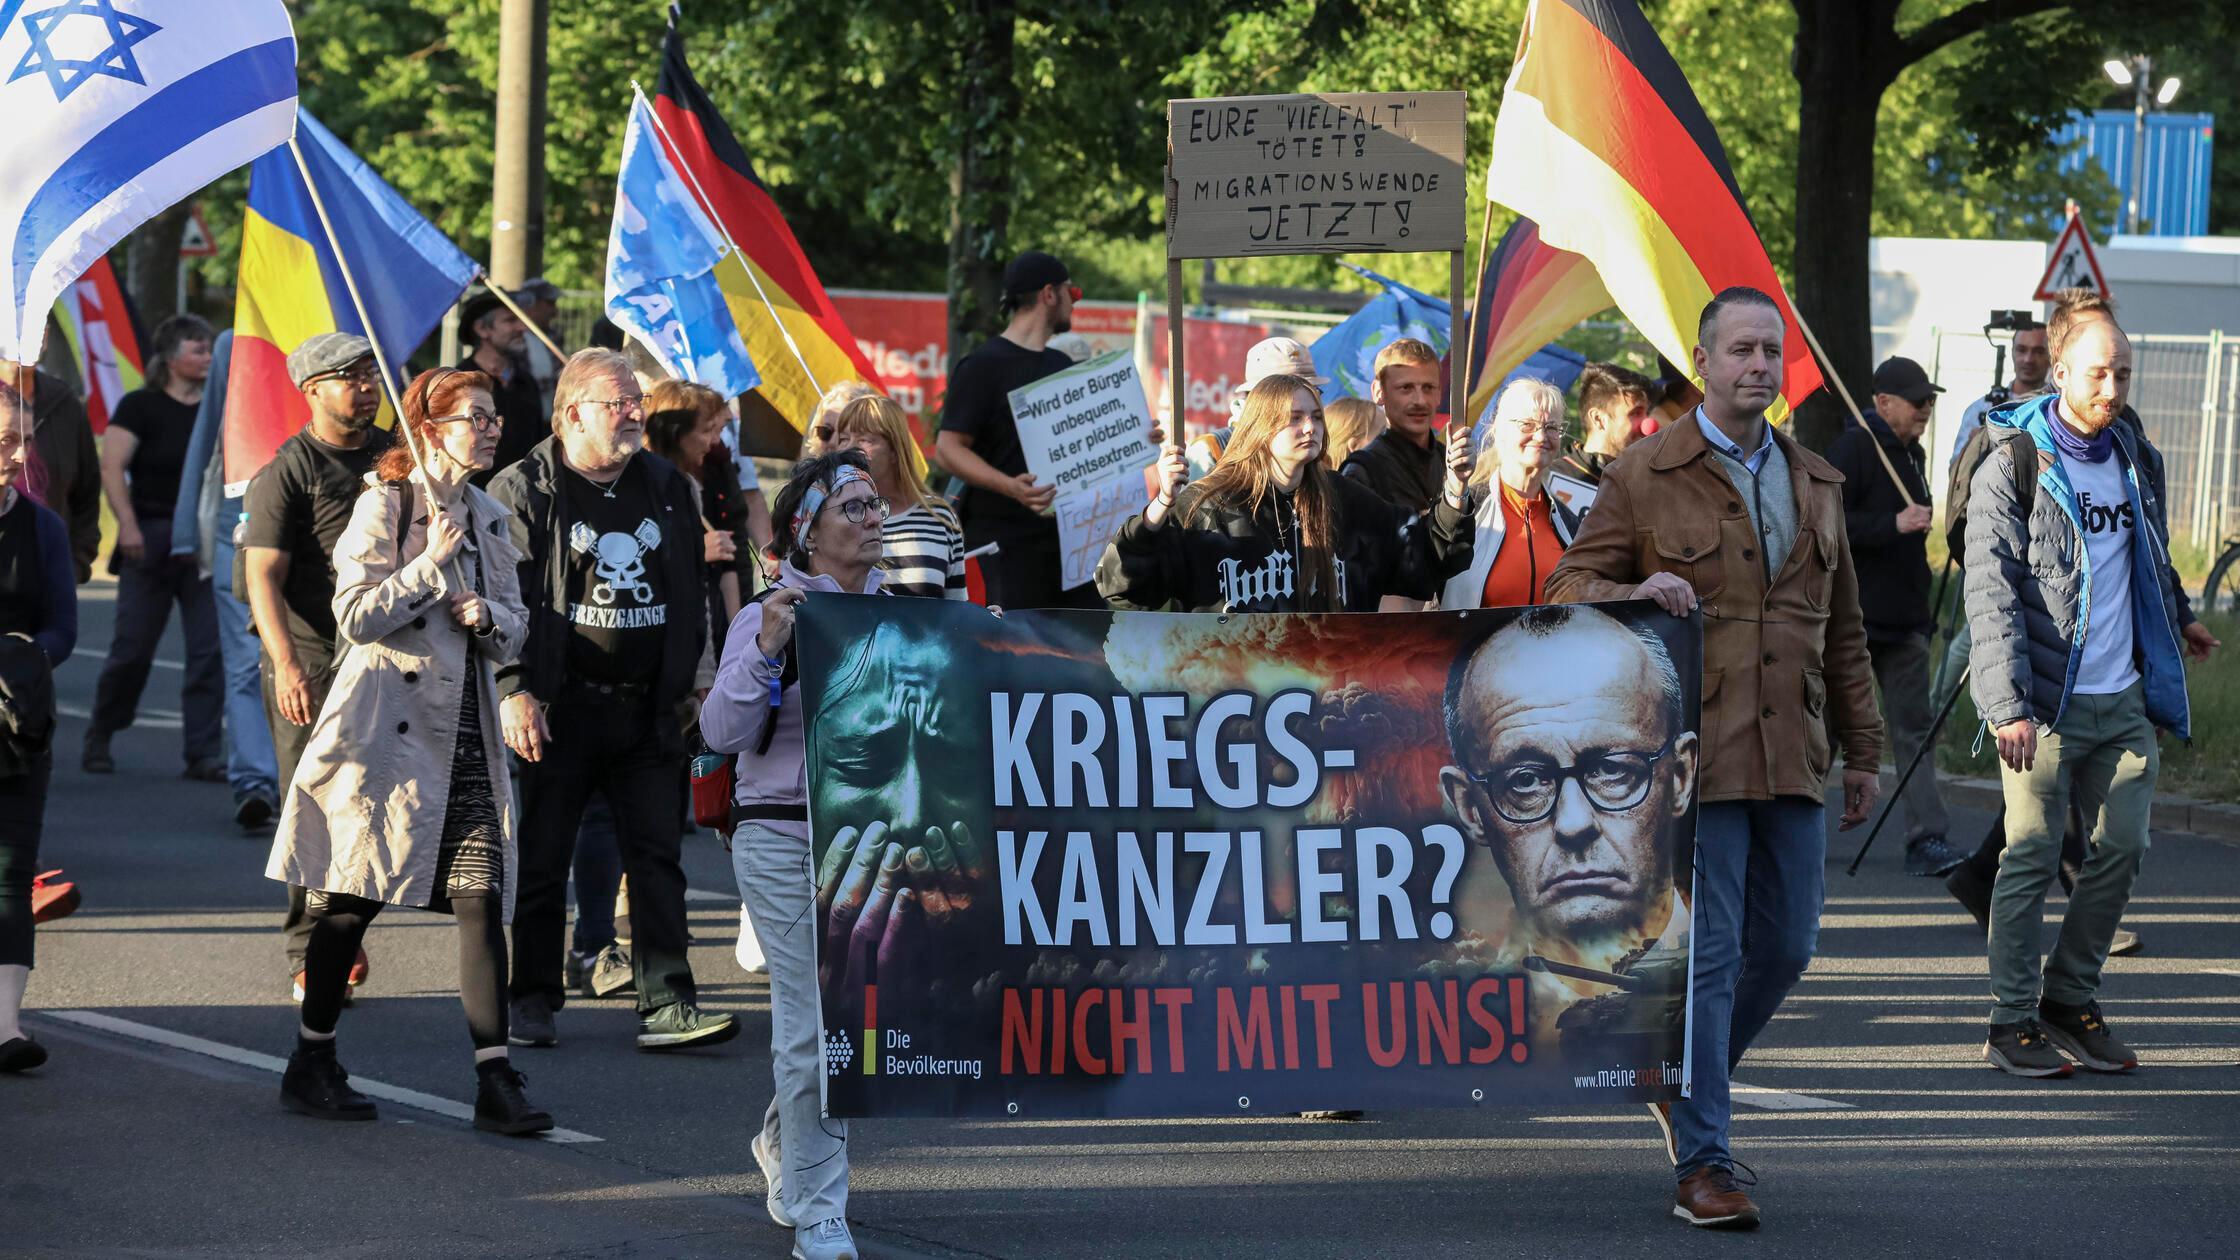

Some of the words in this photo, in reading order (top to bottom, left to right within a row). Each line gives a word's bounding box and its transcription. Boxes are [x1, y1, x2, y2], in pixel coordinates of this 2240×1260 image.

[1190, 107, 1259, 143] EURE
[1278, 99, 1417, 132] "VIELFALT"
[1257, 133, 1366, 160] TÖTET!
[1194, 172, 1440, 200] MIGRATIONSWENDE
[1247, 200, 1413, 241] JETZT!
[1027, 394, 1061, 419] Wird
[1063, 385, 1085, 405] der
[1087, 366, 1132, 395] Bürger
[1048, 448, 1067, 463] ist
[1069, 439, 1082, 455] er
[1085, 413, 1141, 448] plötzlich
[1051, 398, 1126, 436] unbequem,
[1055, 439, 1147, 486] rechtsextrem.
[990, 689, 1356, 809] KRIEGS-
[996, 824, 1466, 946] KANZLER?
[886, 1029, 911, 1049] Die
[1000, 987, 1193, 1076] NICHT
[1215, 983, 1340, 1073] MIT
[1362, 977, 1531, 1068] UNS!
[886, 1055, 982, 1079] Bevölkerung
